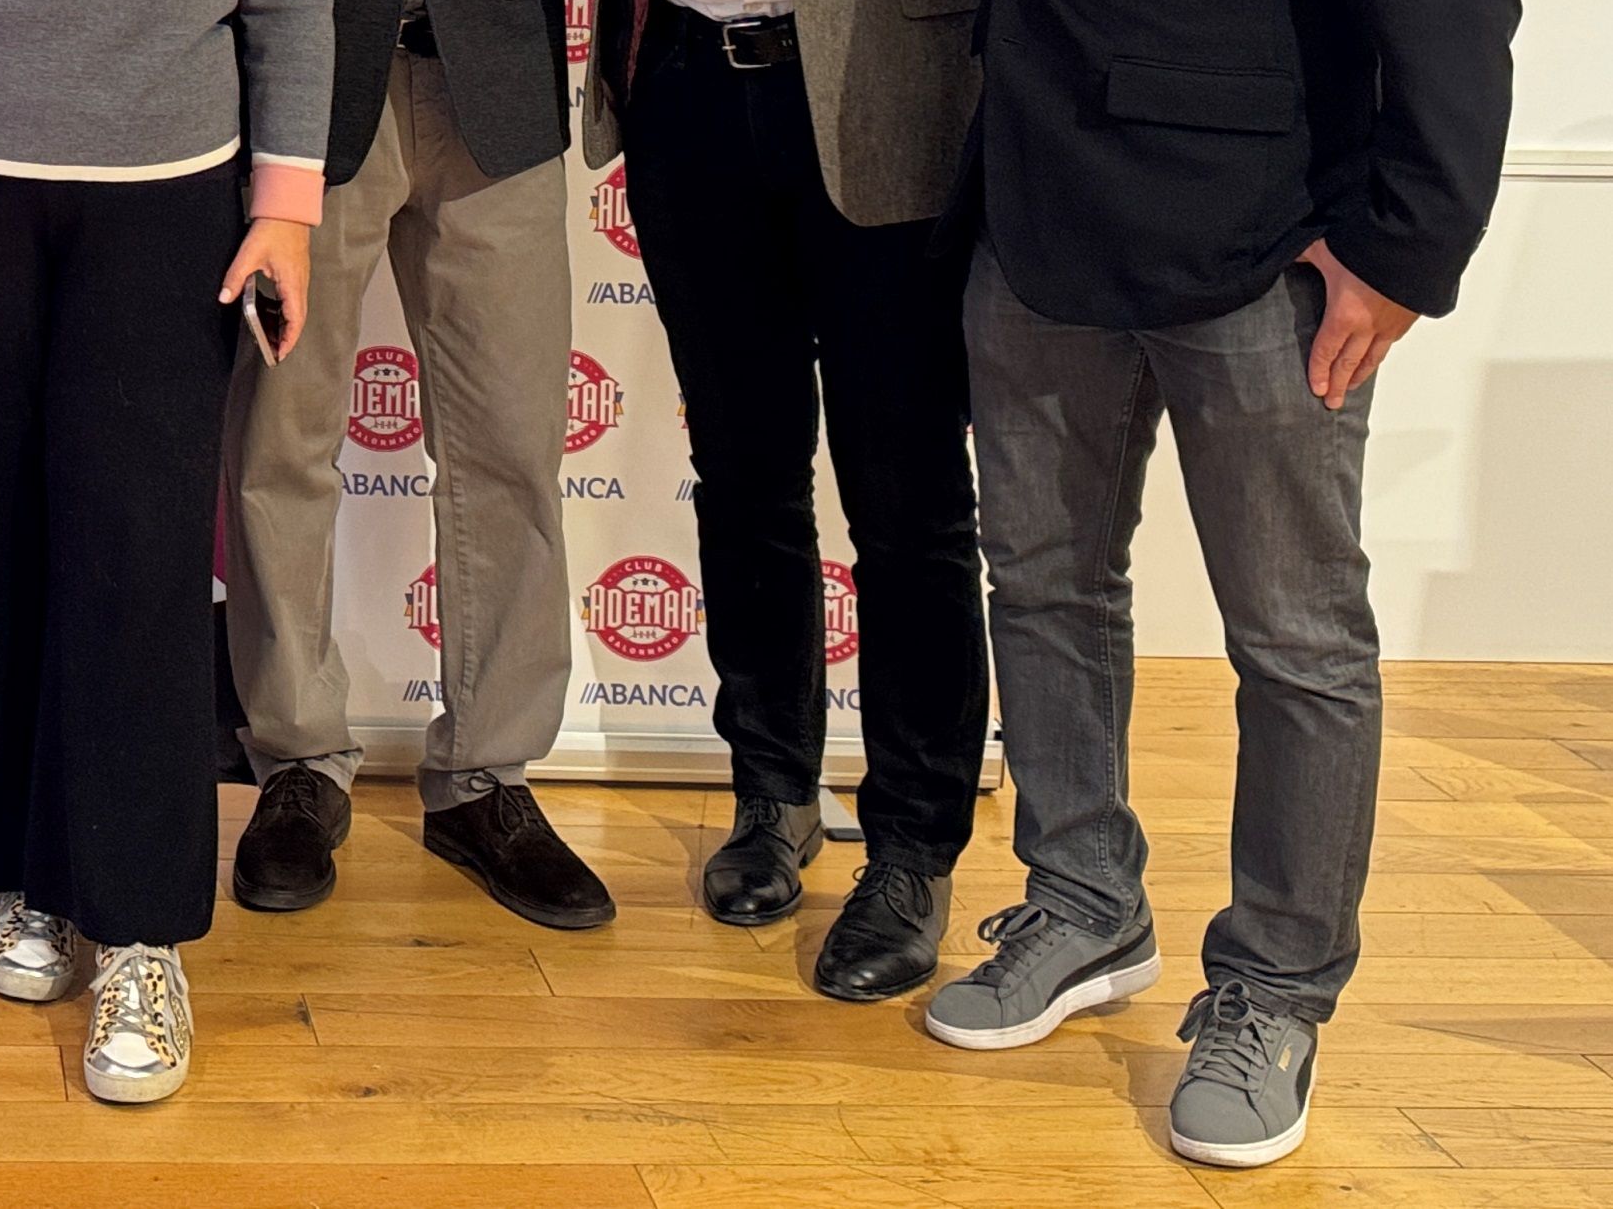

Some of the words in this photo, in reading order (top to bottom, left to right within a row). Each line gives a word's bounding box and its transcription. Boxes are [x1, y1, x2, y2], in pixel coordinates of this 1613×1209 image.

[366, 352, 404, 363] CLUB
[624, 561, 663, 573] CLUB
[589, 583, 698, 634] ADEMAR
